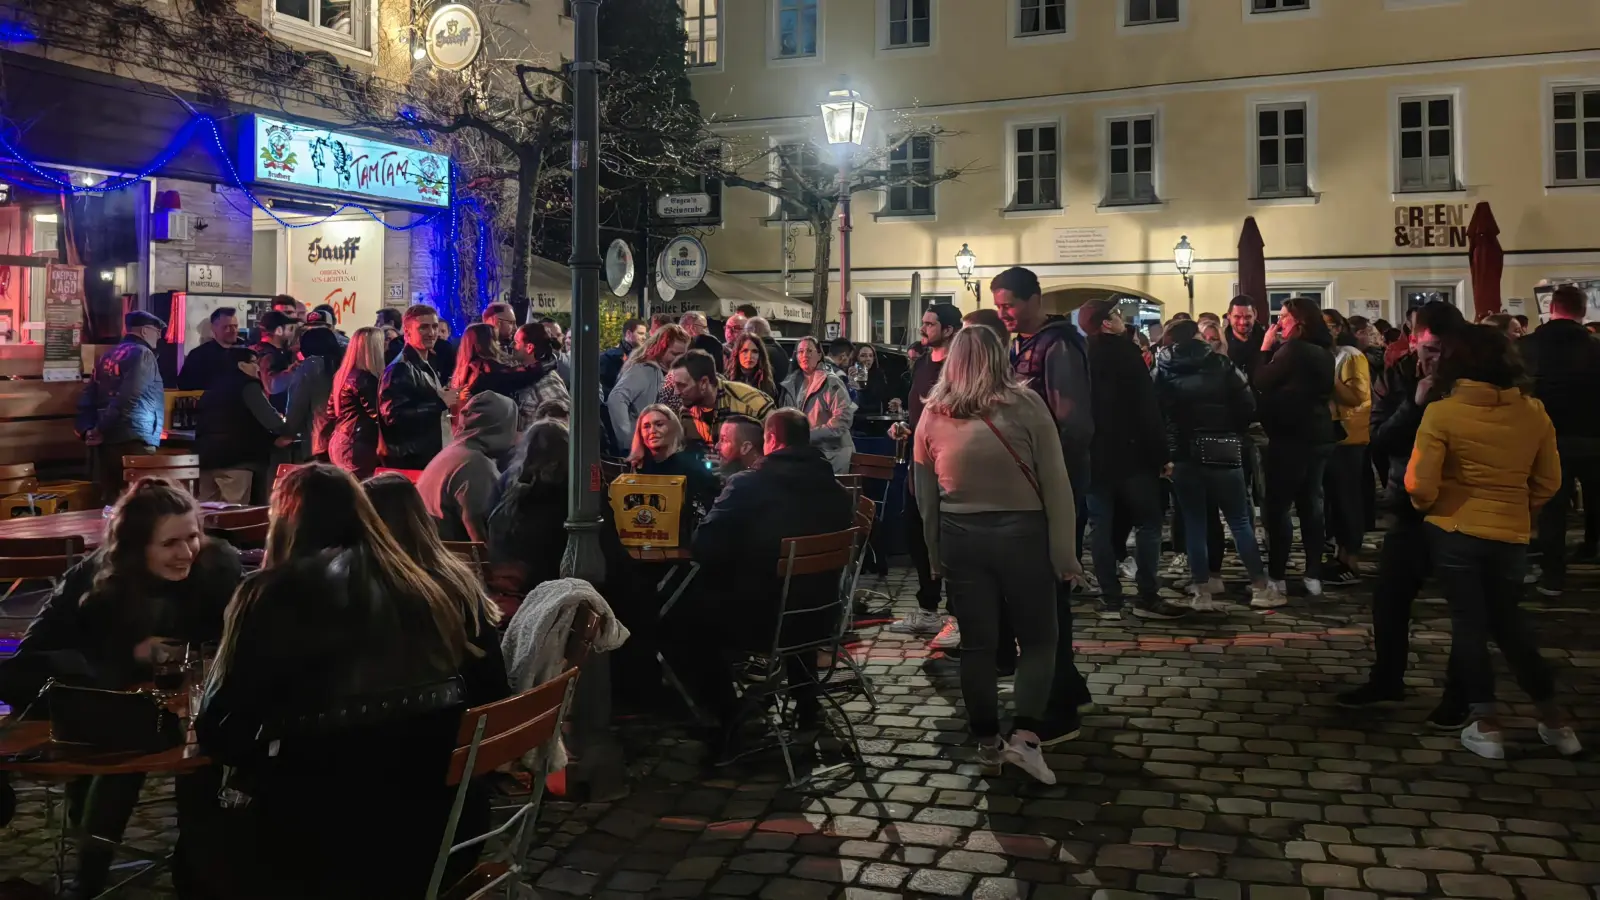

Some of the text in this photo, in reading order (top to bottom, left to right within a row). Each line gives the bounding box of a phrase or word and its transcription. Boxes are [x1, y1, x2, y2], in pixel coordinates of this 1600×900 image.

[307, 236, 361, 266] Hauff
[199, 267, 213, 280] 33
[675, 268, 691, 277] Bier
[537, 292, 556, 308] Bier
[651, 301, 677, 314] palter
